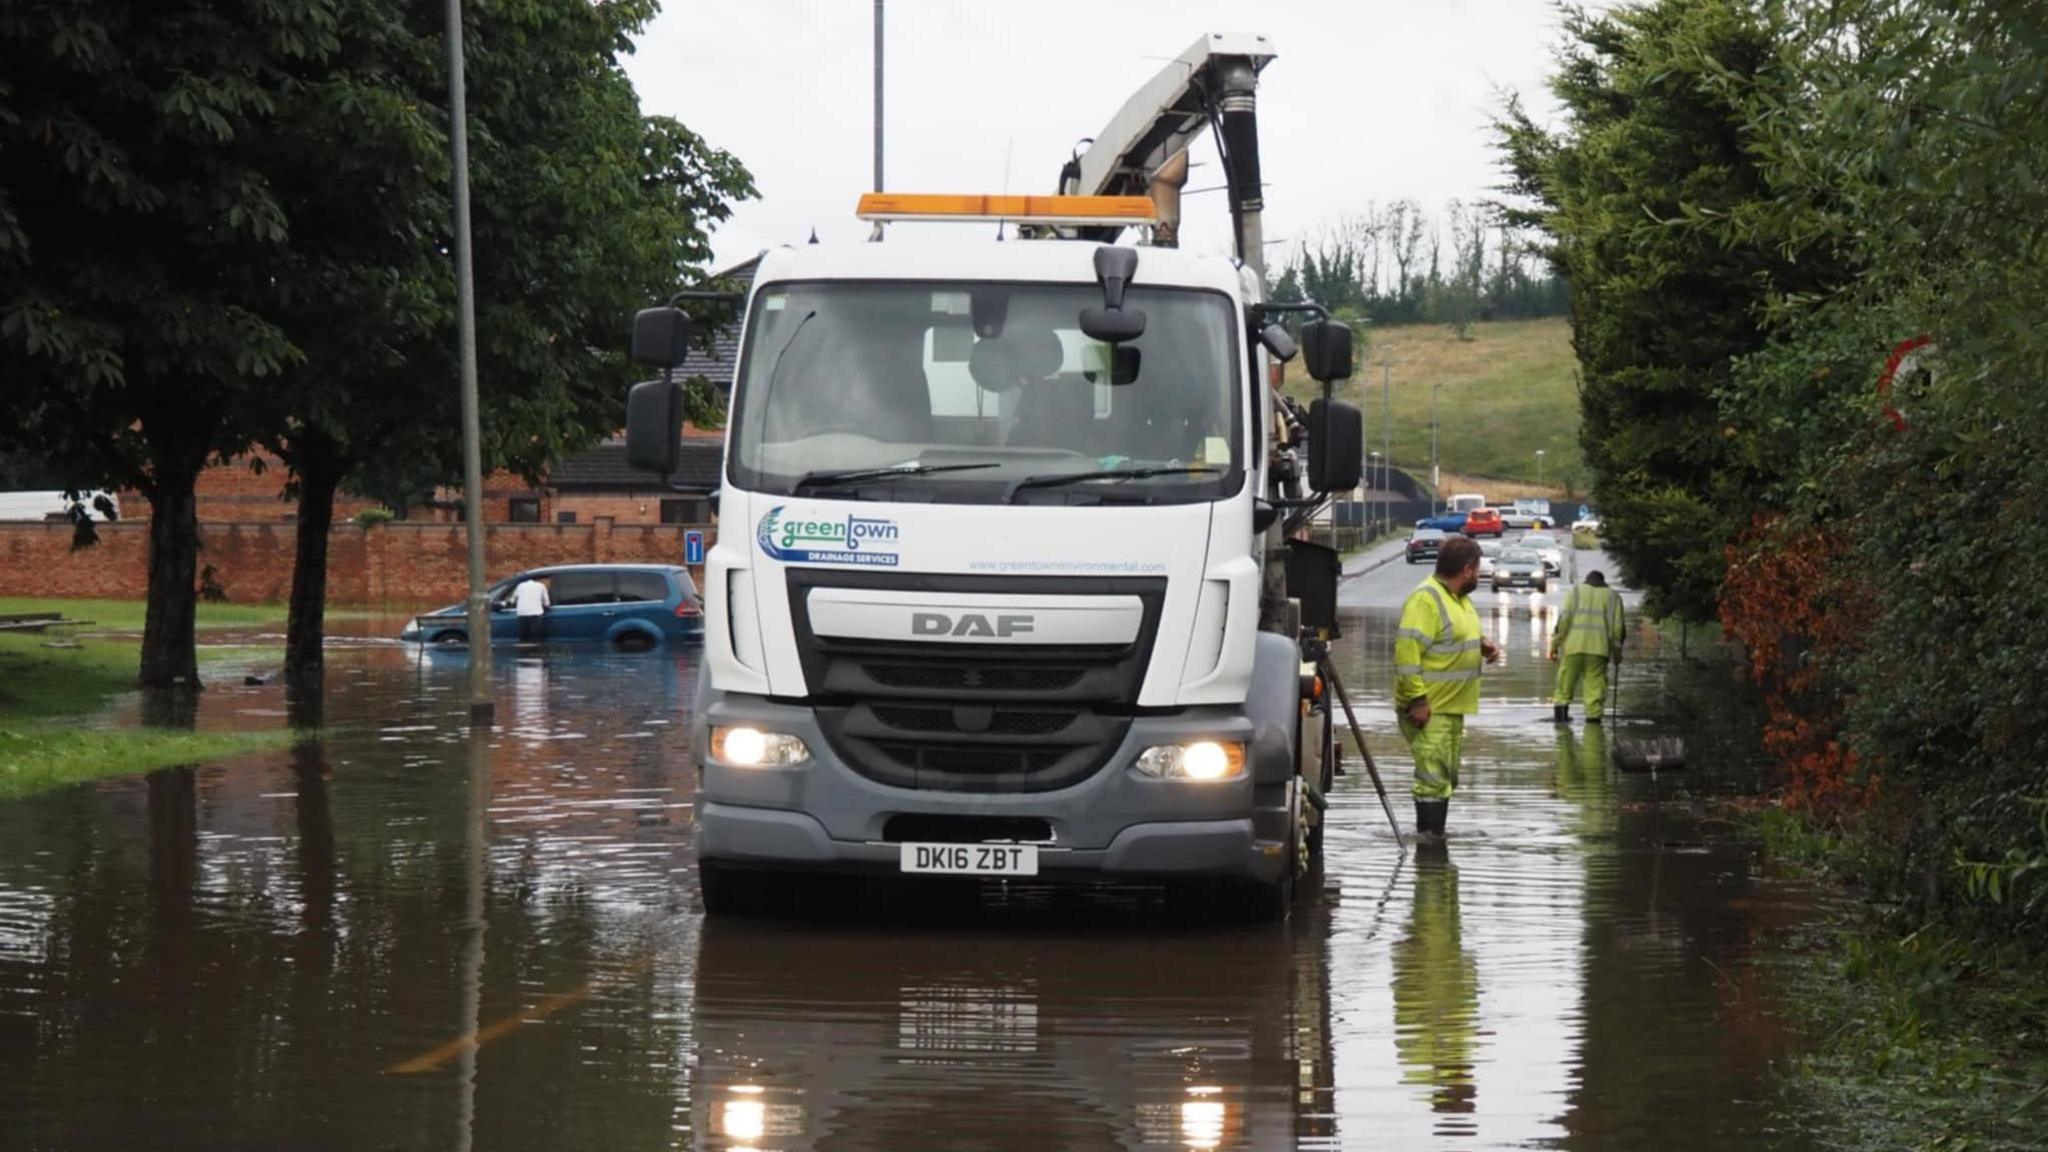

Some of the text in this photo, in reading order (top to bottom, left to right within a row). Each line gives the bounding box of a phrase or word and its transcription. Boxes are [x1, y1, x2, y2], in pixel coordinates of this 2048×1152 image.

[782, 514, 899, 550] greentown
[808, 552, 896, 565] DRAINAGE SERVICES
[968, 560, 1166, 573] www.greentownenvironmental.com
[912, 612, 1034, 638] DAF
[916, 847, 1023, 871] DK16 ZBT
